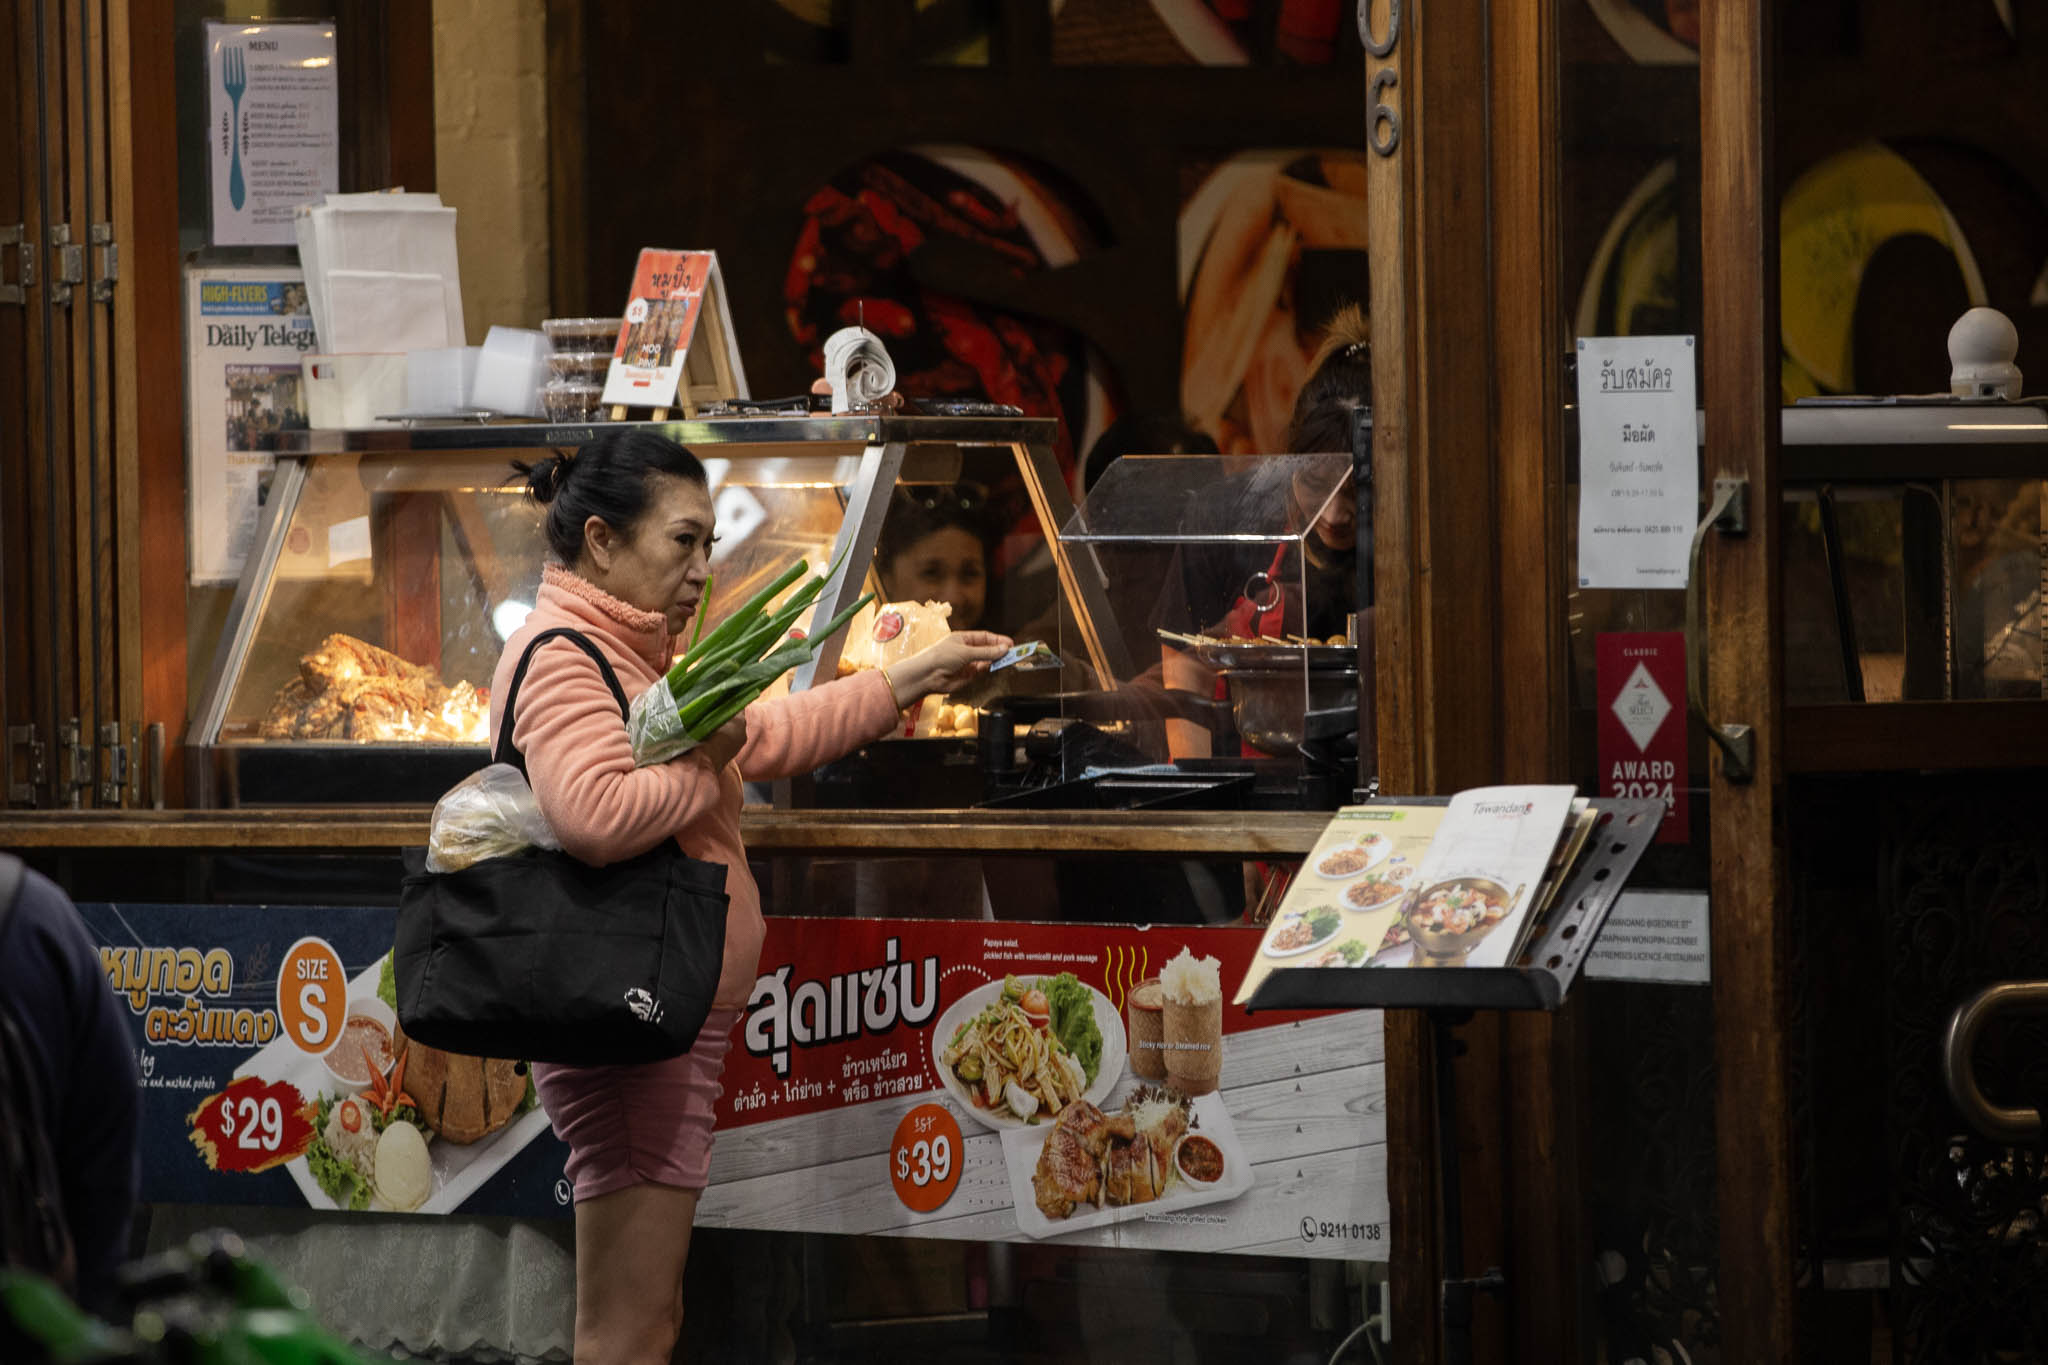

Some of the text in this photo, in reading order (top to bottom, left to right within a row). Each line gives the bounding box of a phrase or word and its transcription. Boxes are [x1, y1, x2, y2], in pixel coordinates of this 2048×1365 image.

[249, 41, 279, 51] MENU
[202, 285, 268, 302] HIGH-FLYERS
[207, 324, 257, 351] Daily
[642, 344, 661, 354] MOO
[1600, 359, 1673, 390] รับสมัคร
[1622, 424, 1656, 443] มือผัด
[1612, 761, 1675, 780] AWARD
[1612, 781, 1676, 808] 2024
[1606, 918, 1645, 929] AWANDANG
[984, 938, 1002, 948] Papaya
[296, 958, 329, 981] SIZE
[983, 951, 1002, 961] pickled
[1014, 952, 1025, 960] with
[1052, 953, 1062, 961] and
[1063, 953, 1075, 963] pork
[299, 983, 328, 1045] S
[745, 938, 939, 1075] สุดแซ่บ
[146, 997, 278, 1046] ตะวันแดง
[140, 1049, 155, 1077] leg
[841, 1048, 908, 1079] ข้าวเหนียว
[149, 1075, 164, 1089] and
[193, 1075, 216, 1093] potato
[783, 1077, 823, 1103] ไก่ย่าง
[842, 1073, 923, 1104] หรือ ข้าวสวย
[220, 1097, 283, 1151] $29
[896, 1136, 951, 1187] $39
[1320, 1222, 1381, 1241] 9211 0138
